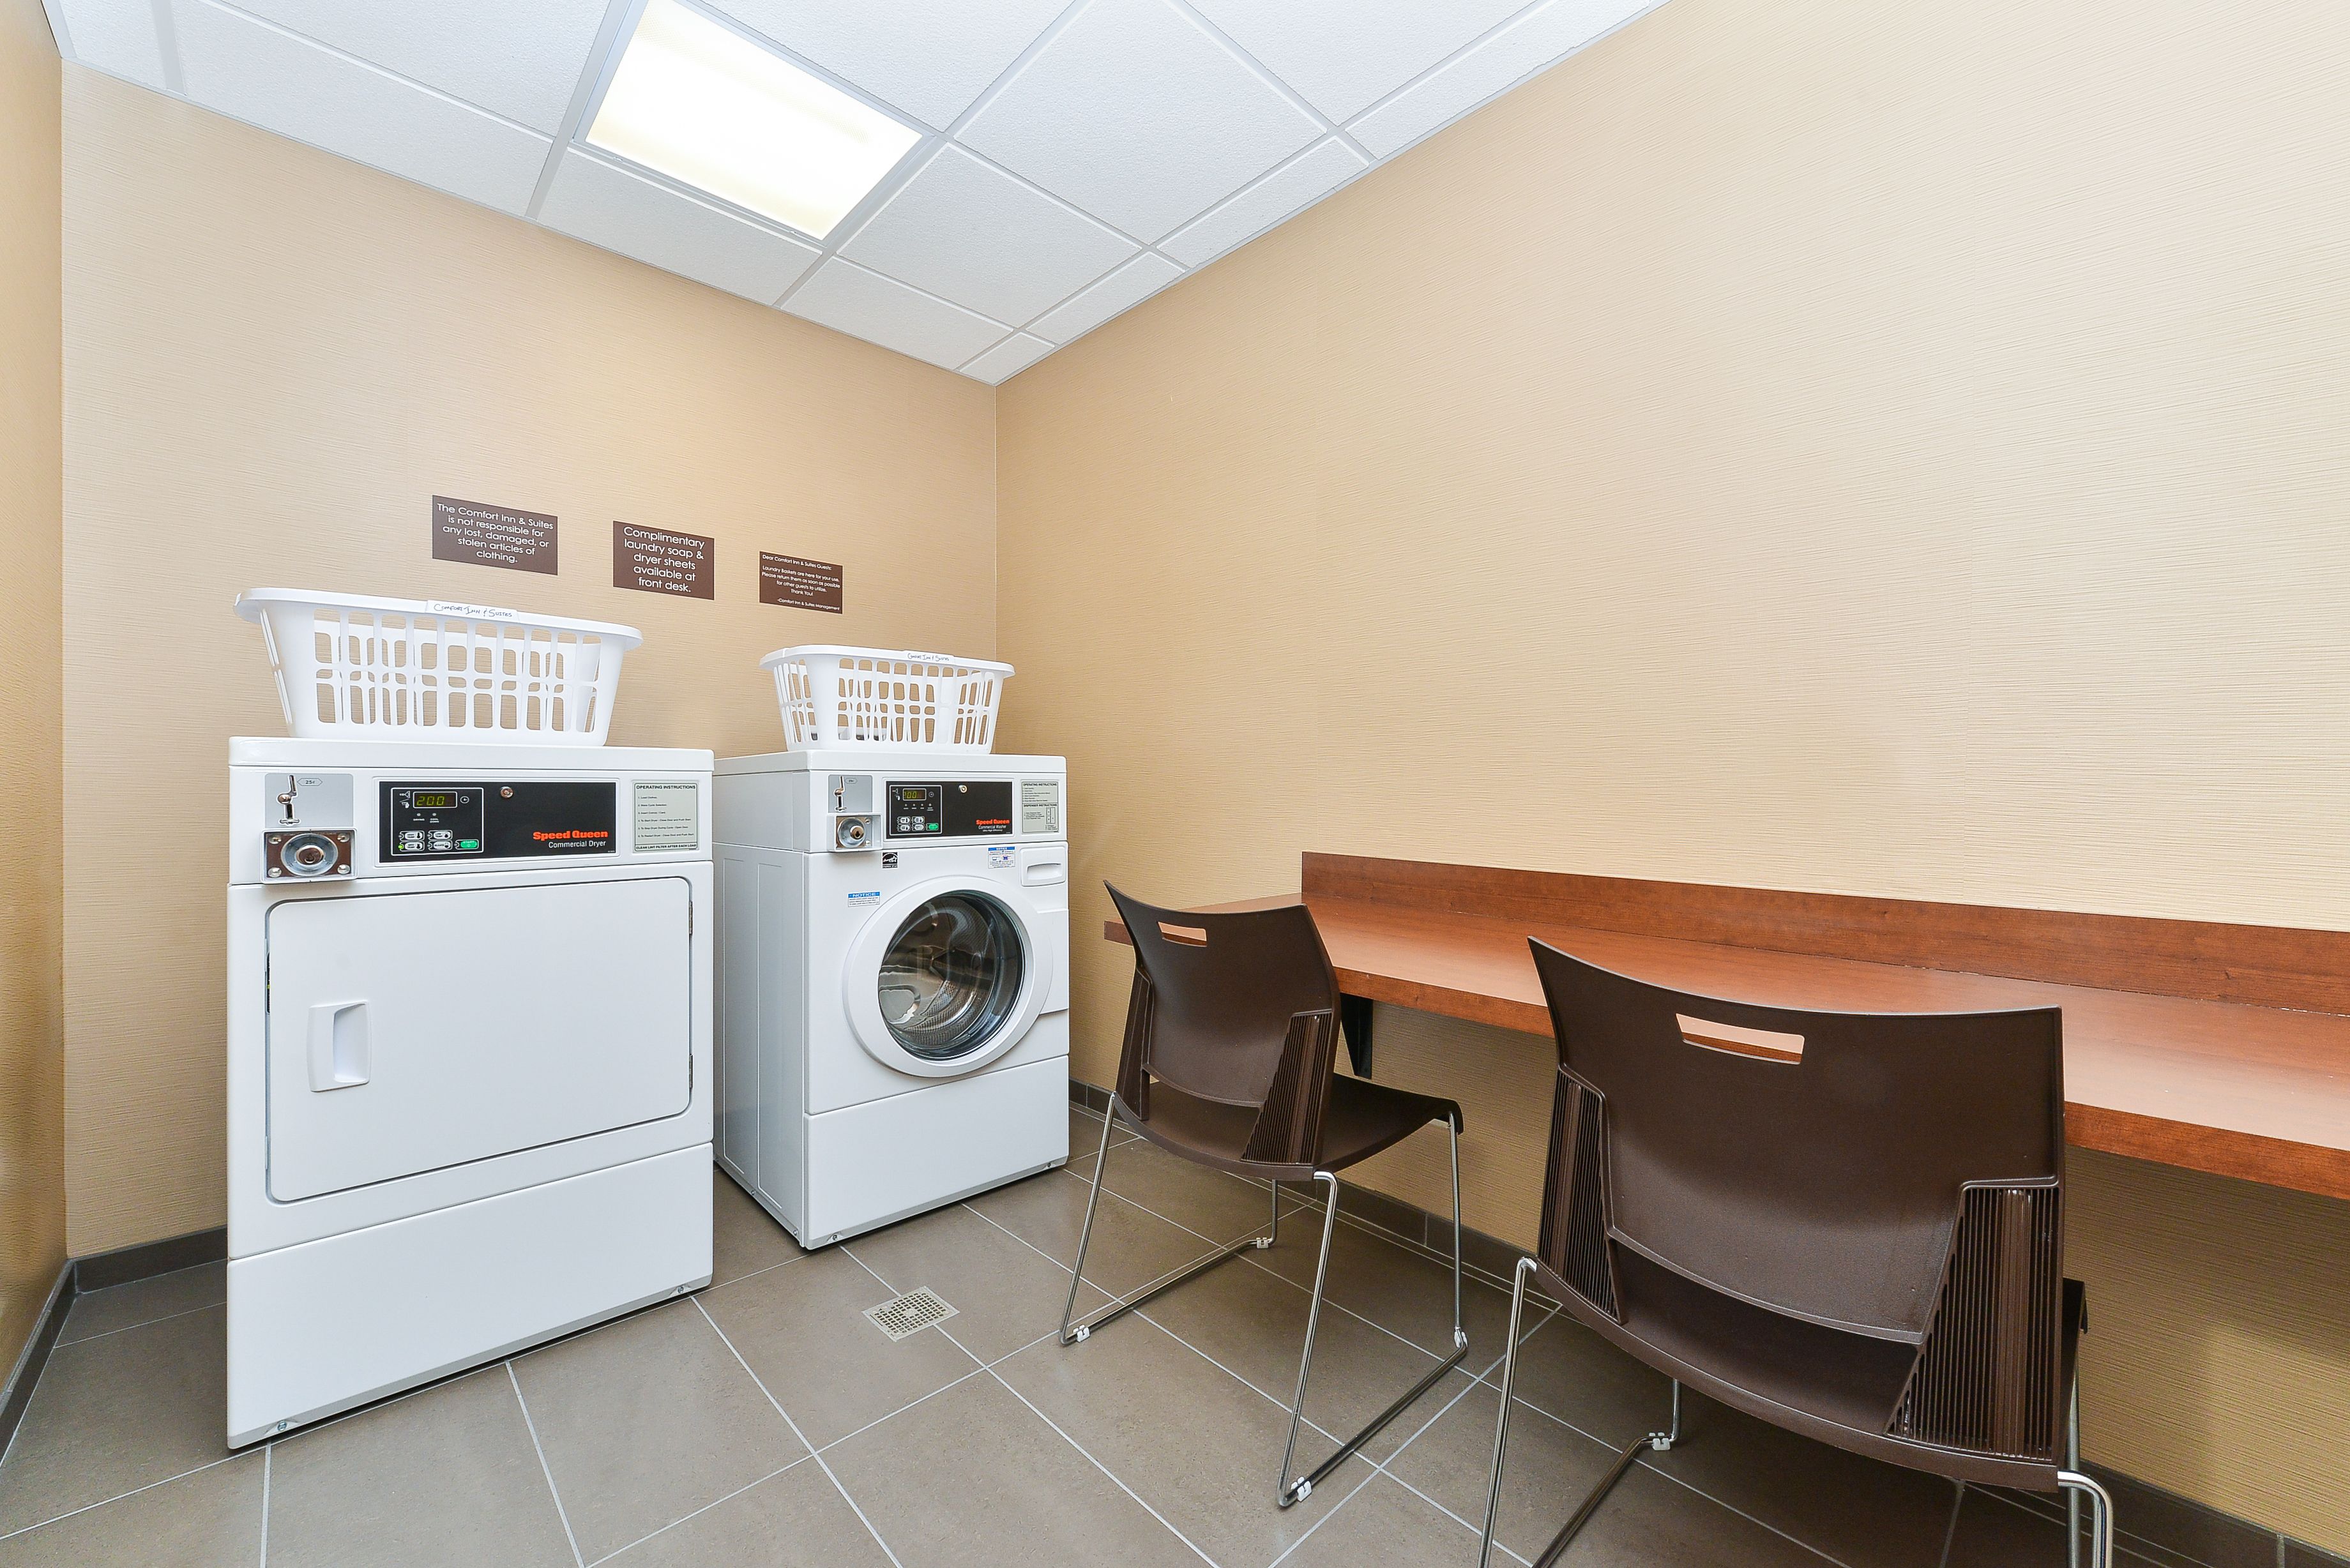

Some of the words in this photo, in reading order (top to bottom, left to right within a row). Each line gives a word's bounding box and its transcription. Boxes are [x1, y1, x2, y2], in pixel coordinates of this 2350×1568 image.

[437, 503, 455, 513] The
[458, 507, 499, 520] Comfort
[501, 515, 515, 523] Inn
[527, 518, 554, 529] Suites
[443, 525, 462, 536] any
[464, 528, 483, 538] lost,
[485, 531, 537, 547] damaged,
[457, 518, 474, 526] not
[476, 521, 529, 535] responsible
[531, 529, 544, 538] for
[623, 526, 705, 549] Complimentary
[457, 538, 487, 548] stolen
[489, 543, 524, 554] articles
[624, 538, 665, 555] laundry
[667, 547, 694, 559] soap
[696, 551, 704, 560] &
[476, 550, 518, 564] clothing.
[633, 553, 662, 565] dryer
[663, 557, 695, 570] sheets
[633, 566, 682, 580] available
[685, 573, 696, 582] at
[639, 577, 662, 589] front
[665, 582, 691, 592] desk.
[416, 796, 445, 806] 200
[533, 831, 571, 841] Speed
[572, 829, 608, 838] Queen
[549, 840, 587, 848] Commercial
[588, 840, 606, 848] Dryer
